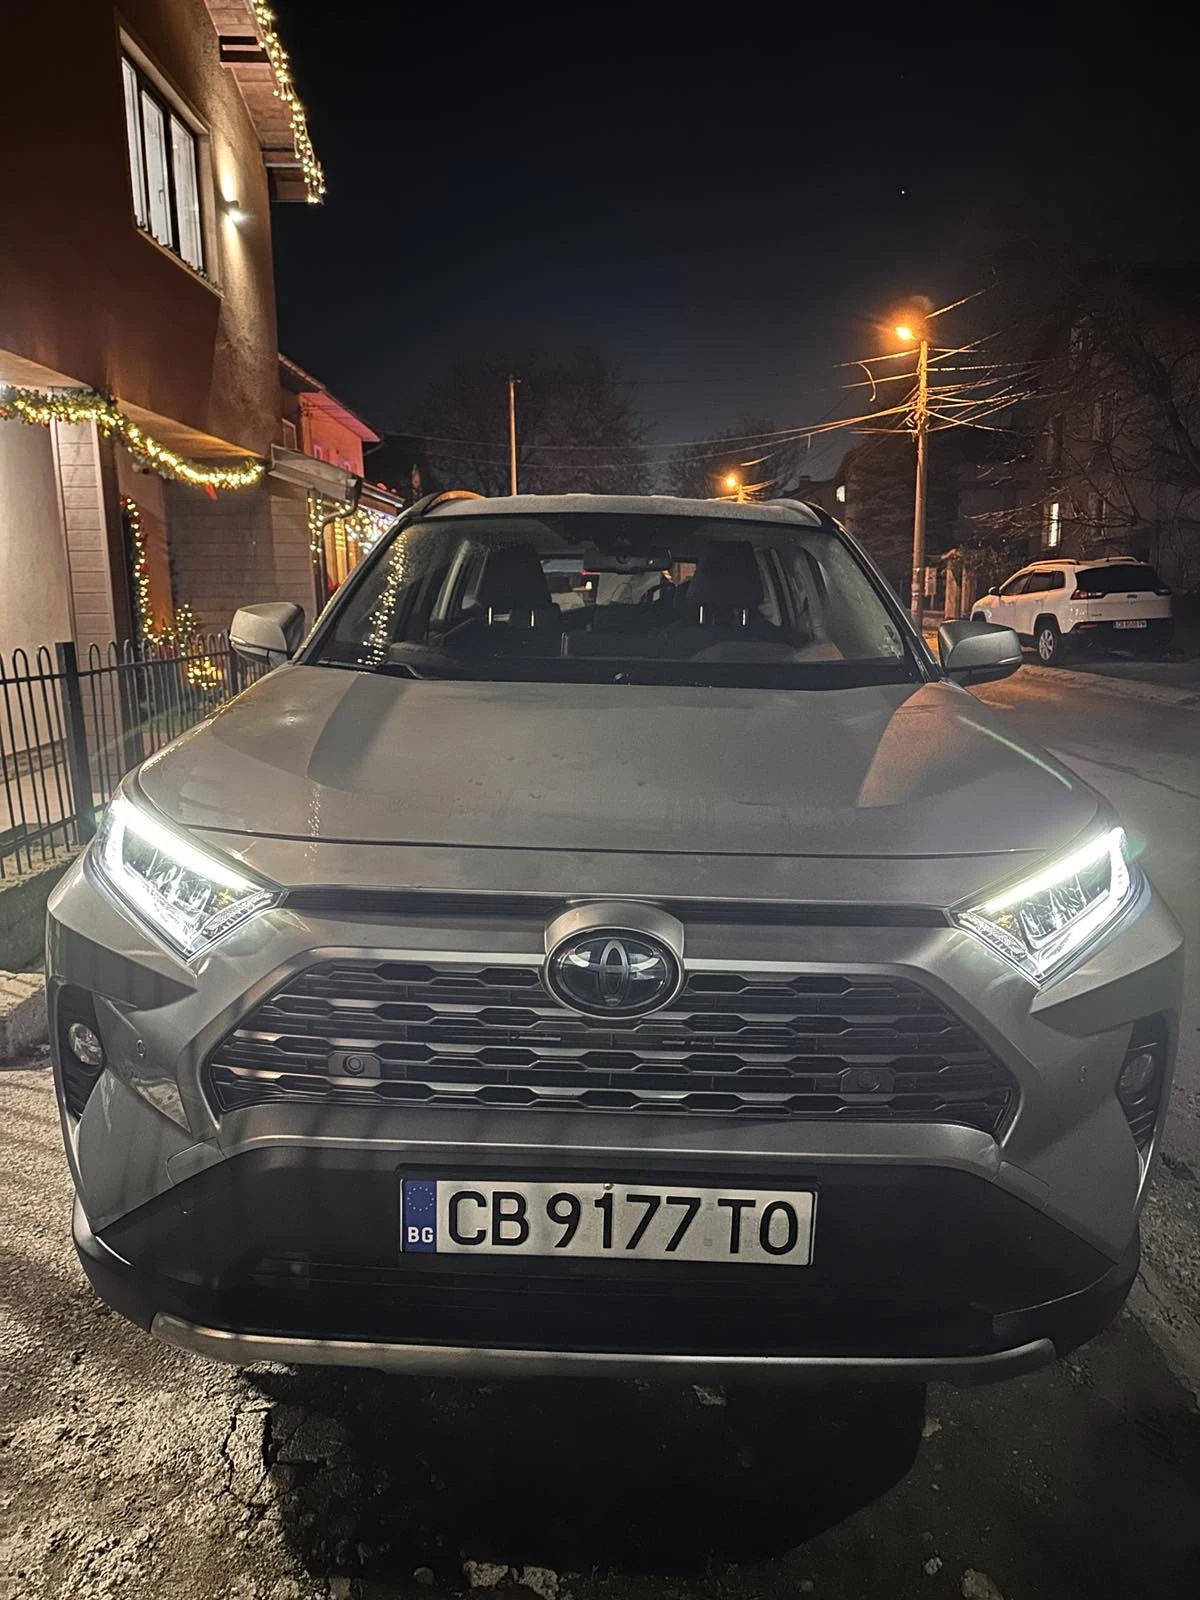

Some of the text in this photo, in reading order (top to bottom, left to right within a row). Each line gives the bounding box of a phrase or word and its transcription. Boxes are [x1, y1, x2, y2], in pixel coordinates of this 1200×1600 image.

[407, 1227, 434, 1244] BG
[447, 1190, 799, 1256] CB 9177 TO
